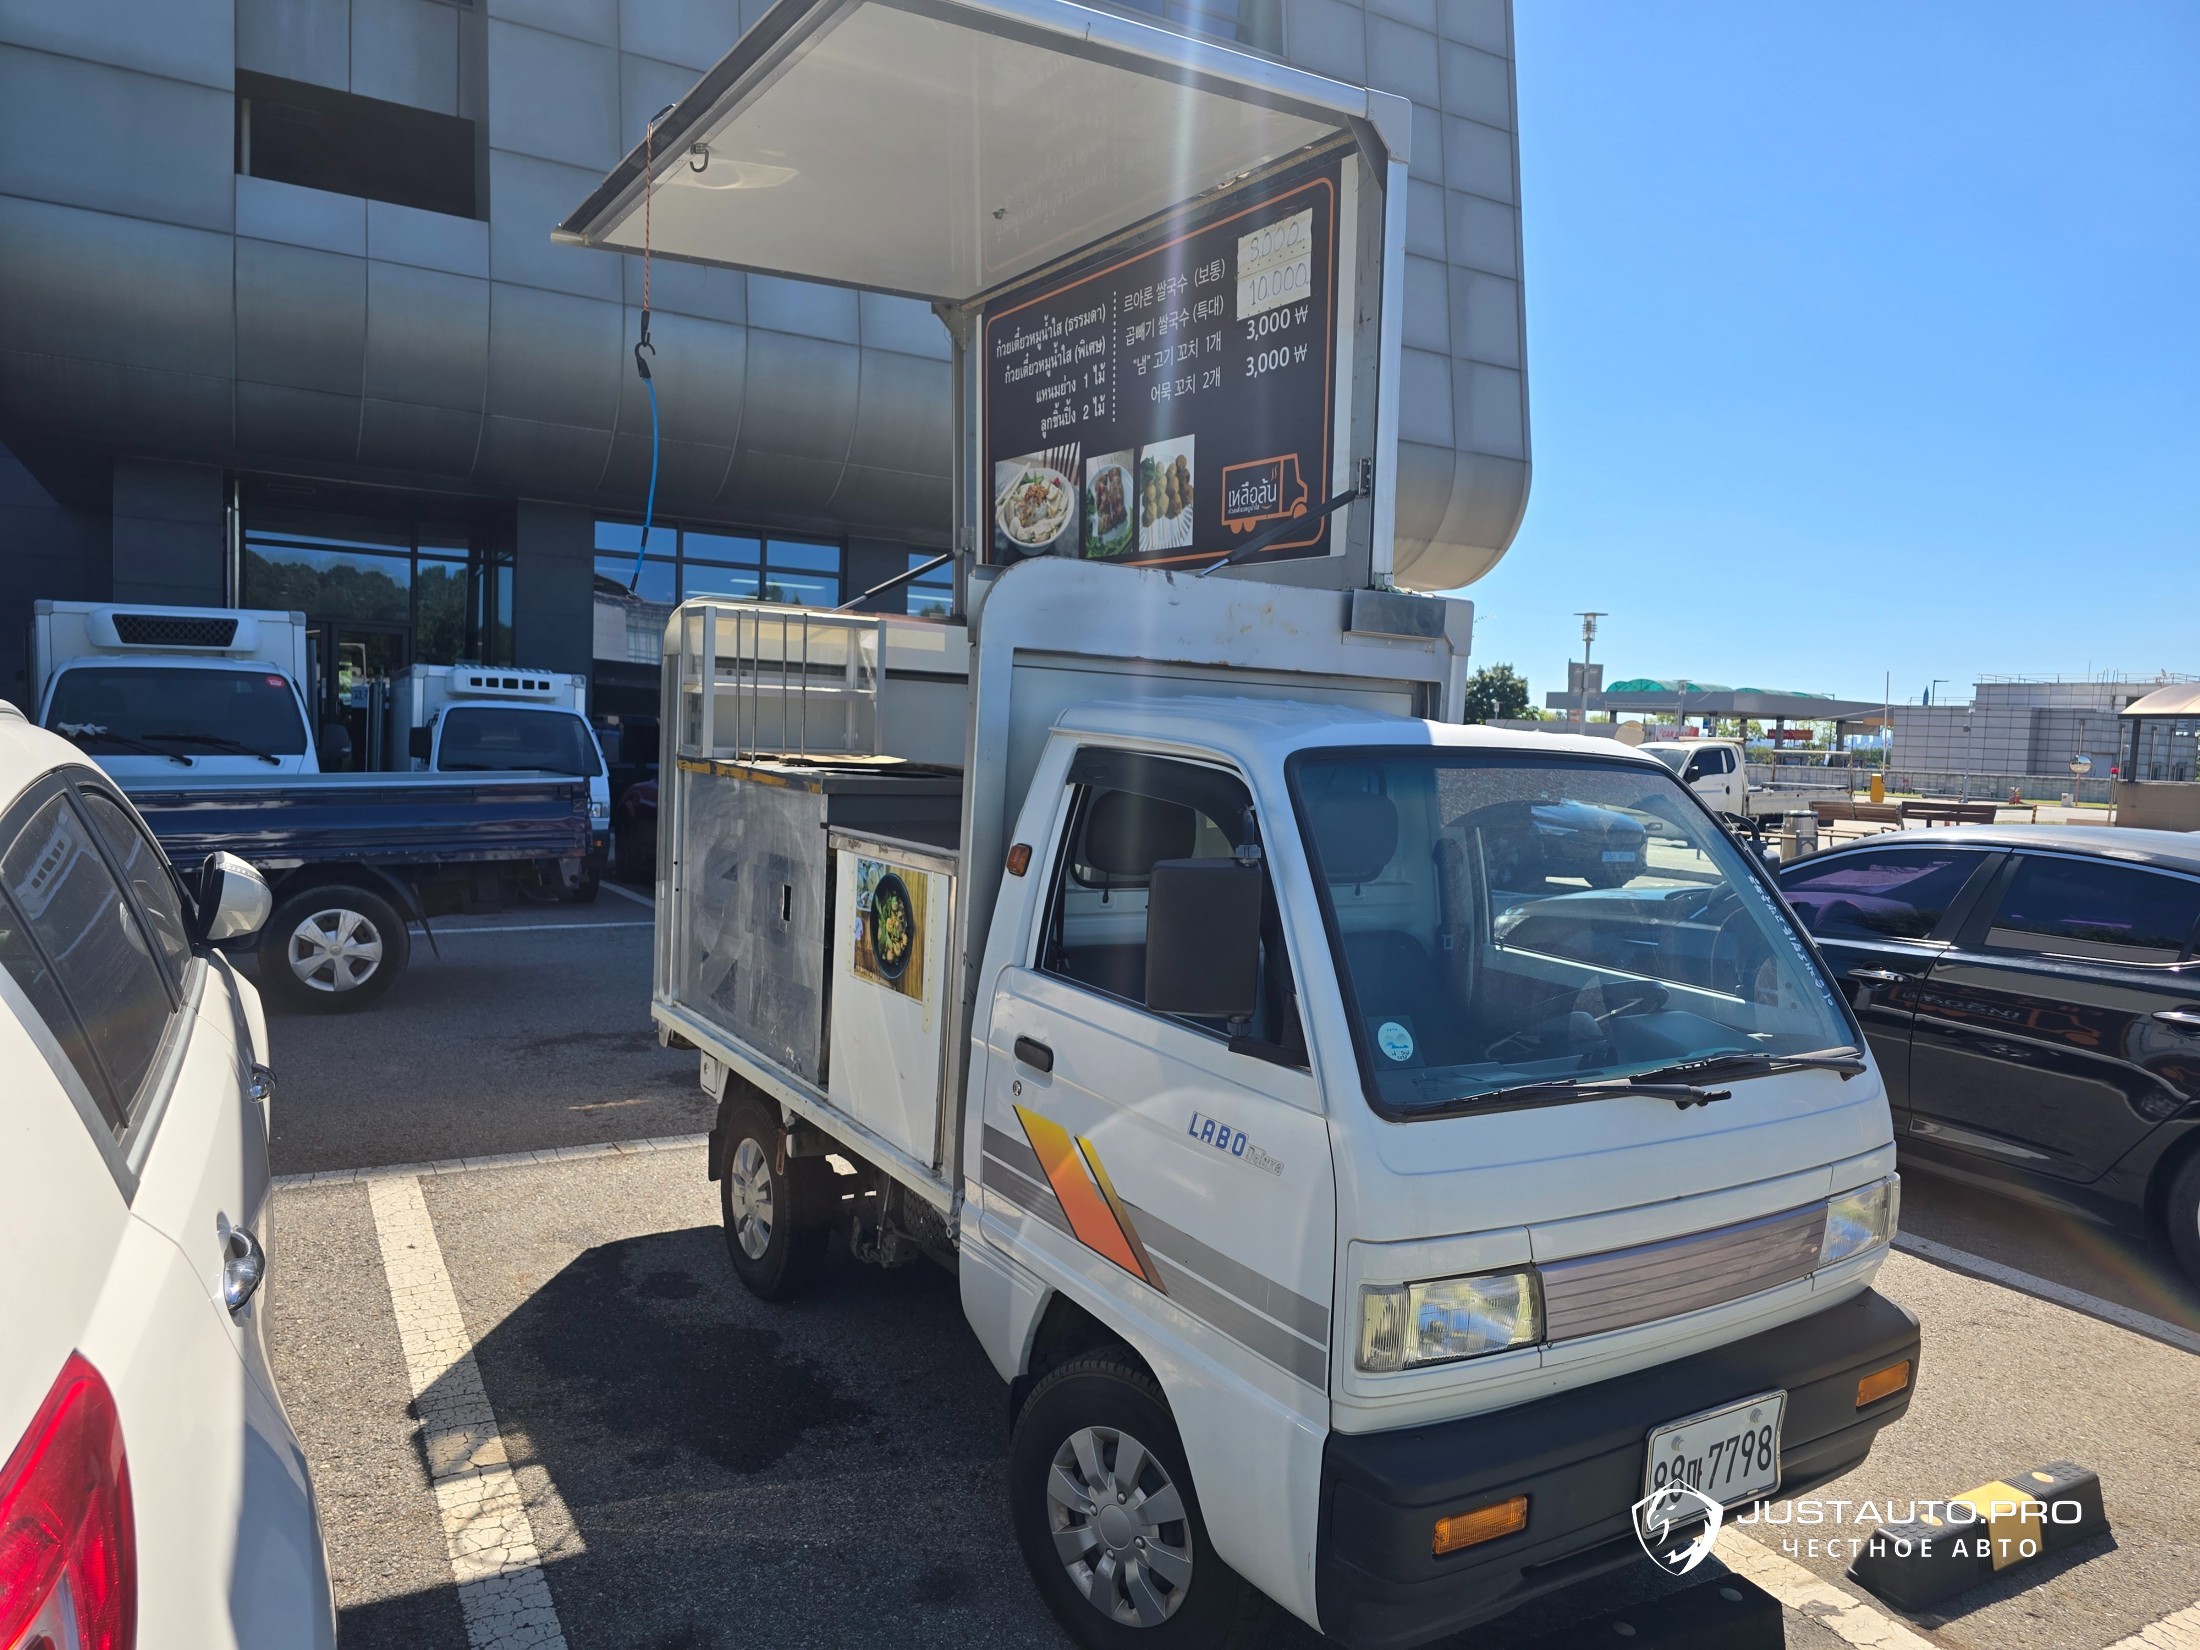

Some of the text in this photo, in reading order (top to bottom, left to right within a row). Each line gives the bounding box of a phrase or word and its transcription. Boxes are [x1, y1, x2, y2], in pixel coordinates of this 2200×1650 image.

[1123, 258, 1225, 312] 르아론 쌀국수 (보통)
[1065, 303, 1105, 337] (ธรรมดา)
[1125, 294, 1224, 347] 곱빼기 쌀국수 (특대)
[1246, 308, 1290, 341] 3,000
[1074, 335, 1105, 364] (พิเศษ)
[1153, 345, 1173, 369] 고기
[1177, 337, 1199, 361] 꼬치
[1205, 330, 1221, 352] 1개
[1246, 346, 1290, 378] 3,000
[1036, 362, 1105, 403] แหนมย่าง 1 ไม้
[1151, 366, 1221, 404] 어묵 꼬치 2개
[1083, 404, 1089, 420] 2
[1093, 394, 1105, 417] ไม้
[1189, 1113, 1247, 1157] LABO
[1708, 1424, 1772, 1490] 7798
